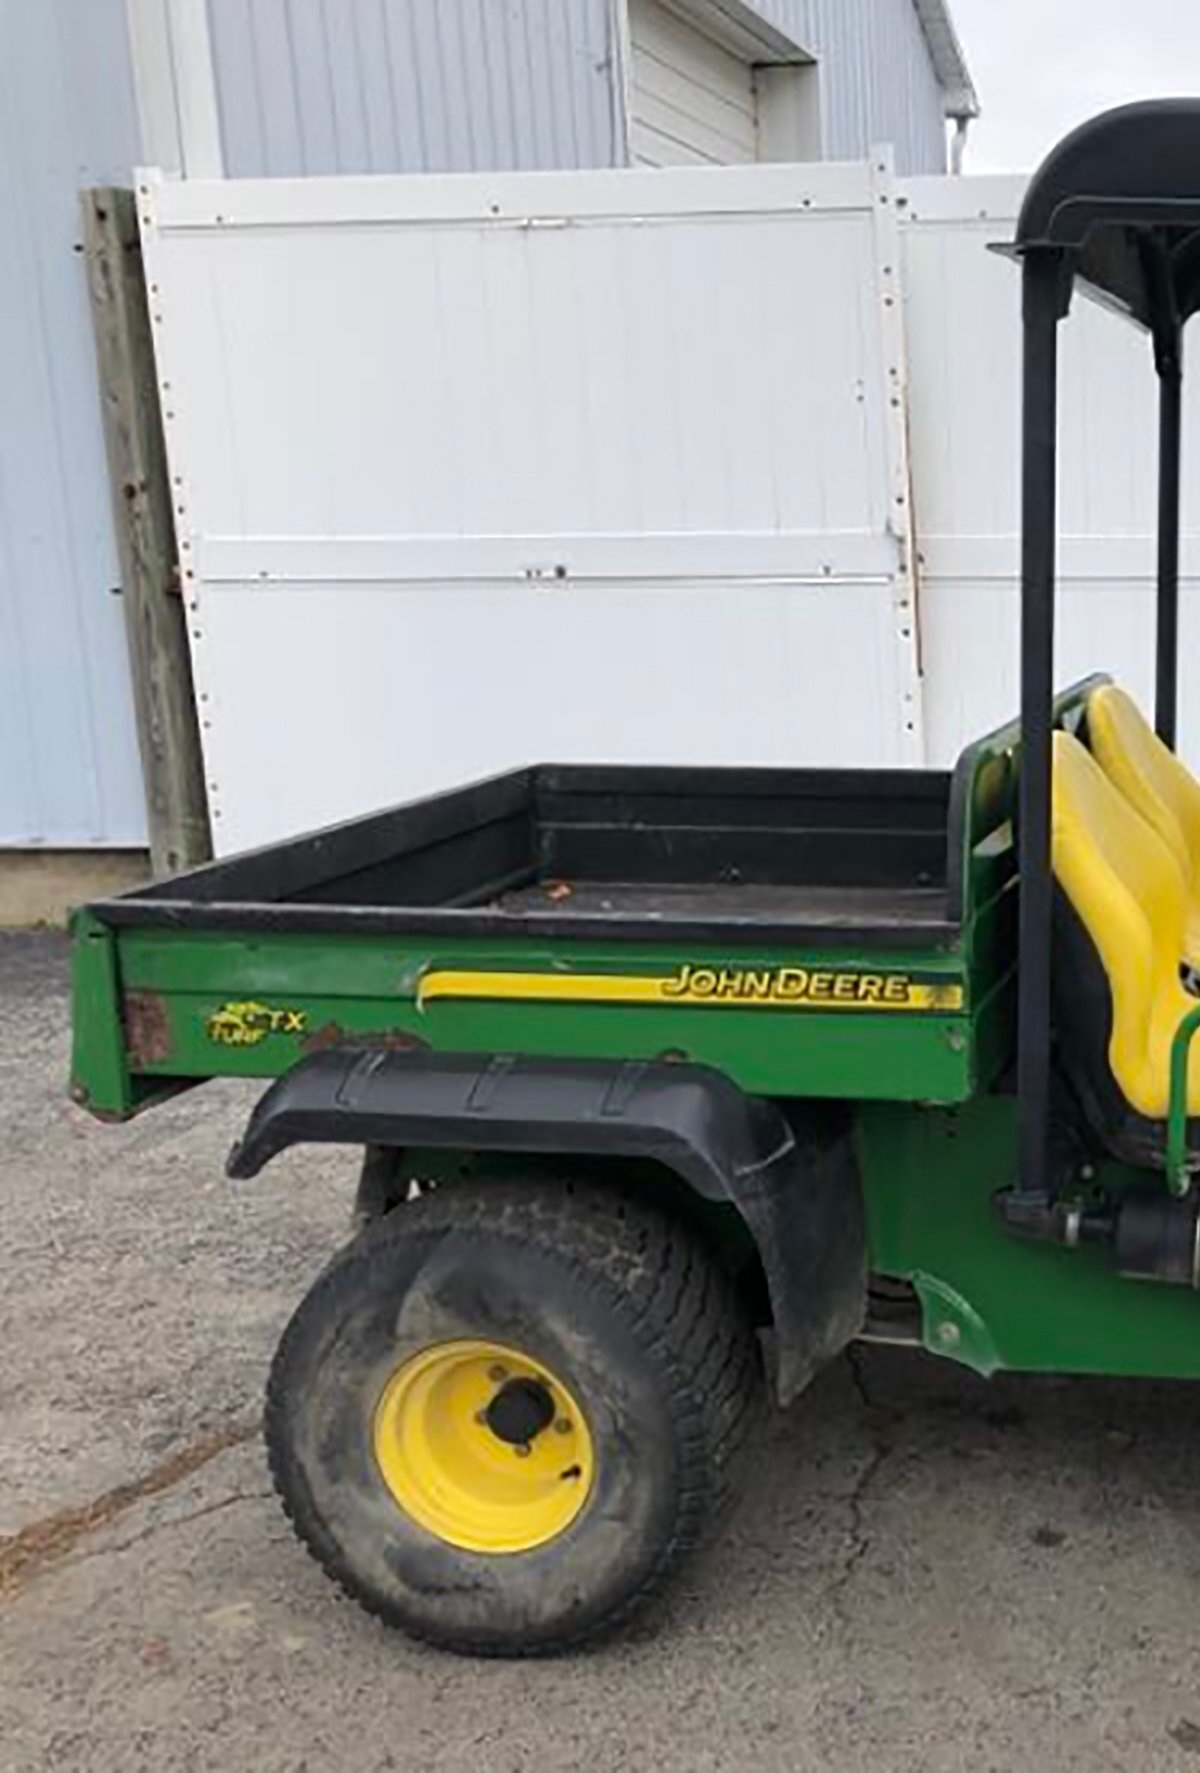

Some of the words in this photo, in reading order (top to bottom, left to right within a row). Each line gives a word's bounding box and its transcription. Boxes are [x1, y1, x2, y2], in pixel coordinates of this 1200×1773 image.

[664, 965, 771, 997] JOHN
[775, 967, 910, 1000] DEERE
[268, 1010, 304, 1031] TX
